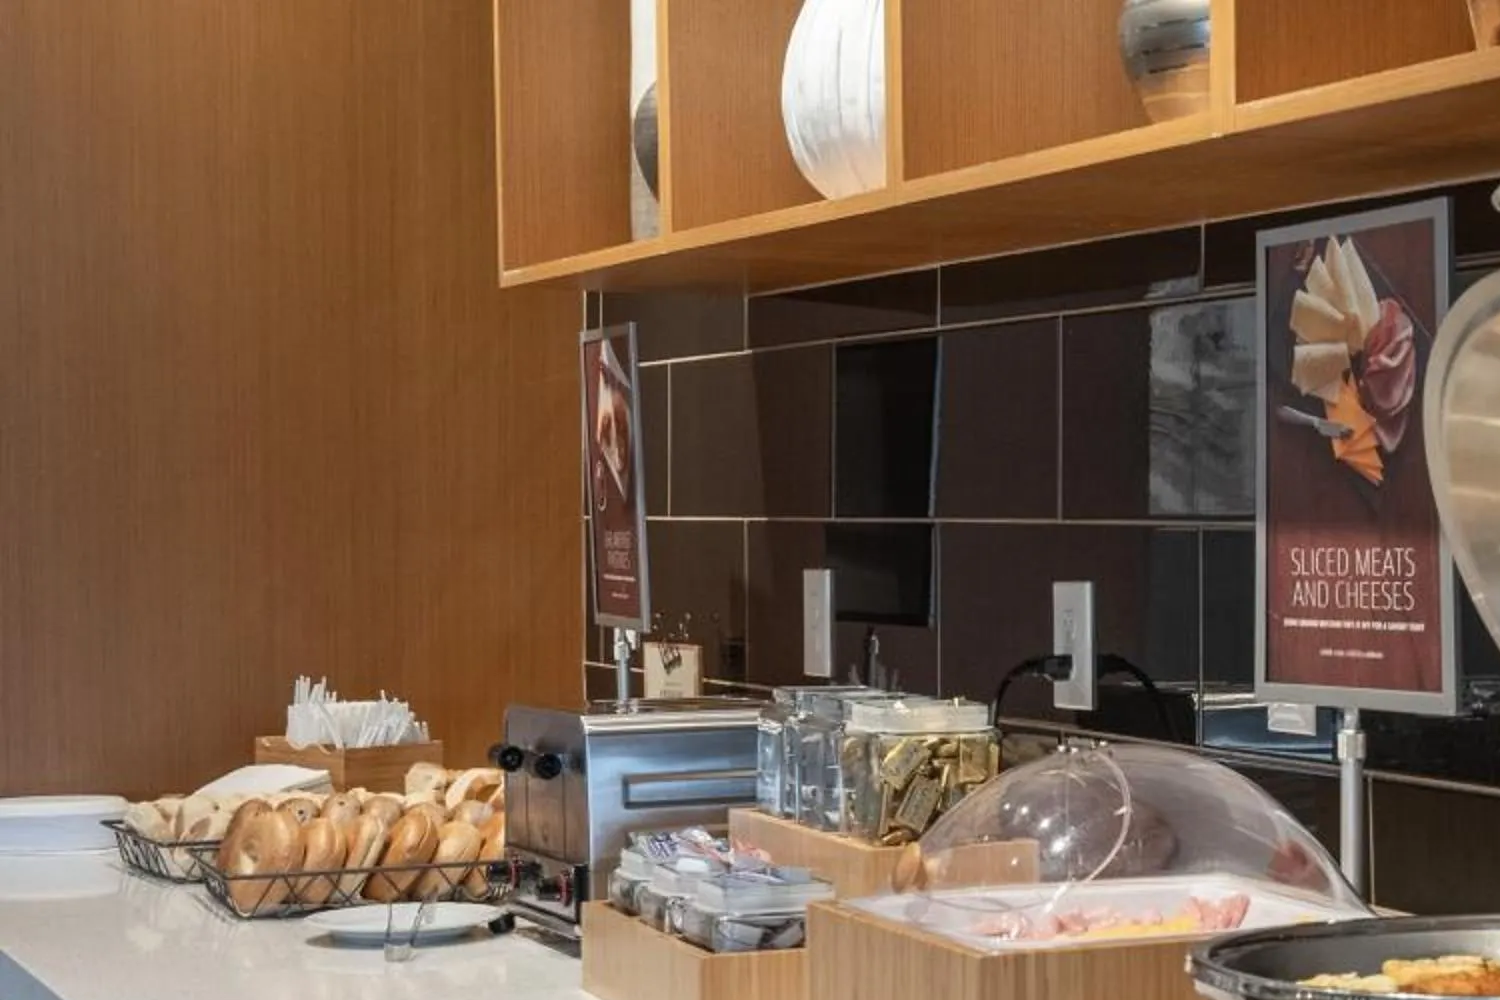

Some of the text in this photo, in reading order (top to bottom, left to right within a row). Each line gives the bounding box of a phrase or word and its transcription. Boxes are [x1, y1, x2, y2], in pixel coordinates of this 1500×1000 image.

[1290, 547, 1416, 578] SLICED MEATS
[1291, 580, 1416, 612] AND CHEESES
